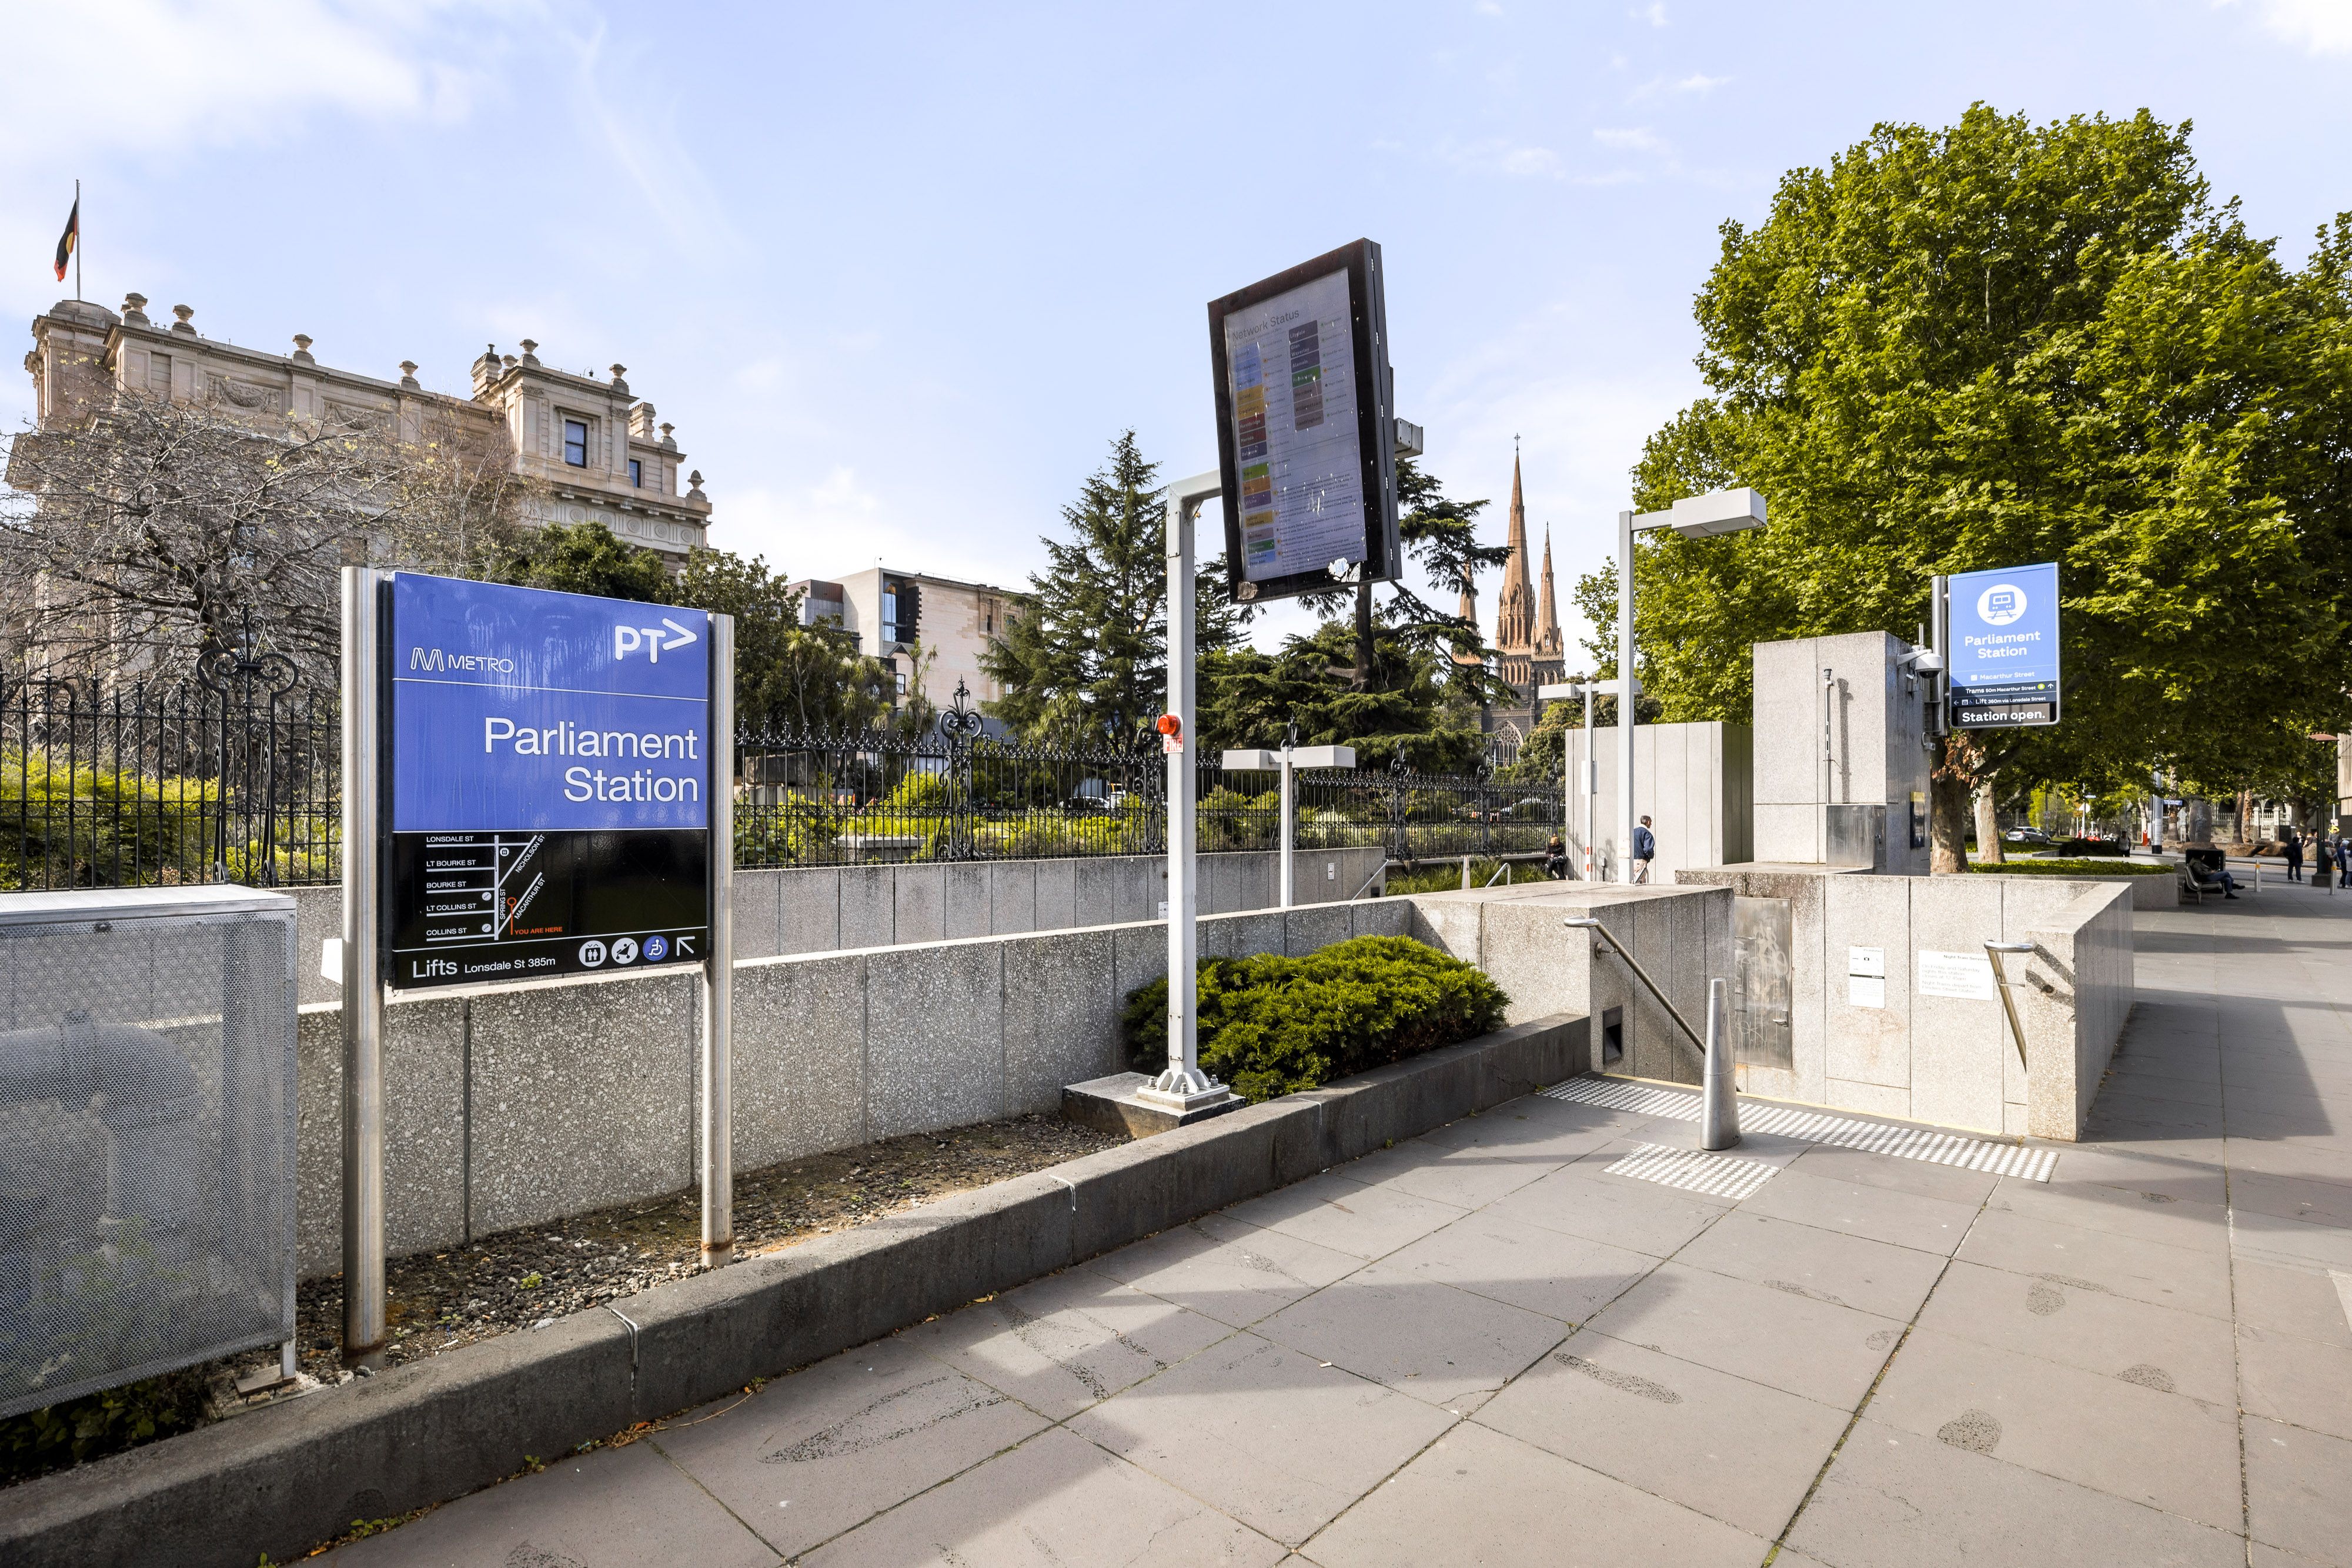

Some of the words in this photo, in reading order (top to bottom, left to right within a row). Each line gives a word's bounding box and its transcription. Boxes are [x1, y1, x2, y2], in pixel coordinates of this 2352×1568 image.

[1233, 320, 1268, 340] Network
[1271, 310, 1299, 327] Status
[1290, 330, 1305, 339] Lilydale
[1291, 348, 1309, 357] Waverley
[1296, 416, 1321, 426] Sandringham
[1965, 631, 2040, 647] Parliament
[1977, 646, 2027, 658] Station
[448, 654, 514, 673] METRO
[1962, 711, 2007, 722] Station
[2010, 711, 2046, 721] open.
[485, 717, 699, 760] Parliament
[1164, 738, 1182, 751] FIRE
[563, 767, 699, 803] Station
[515, 844, 540, 873] NICHOLSON
[537, 834, 545, 844] ST
[514, 884, 540, 920] MACARTHUR
[537, 878, 545, 887] ST
[413, 959, 457, 978] Lifts
[465, 961, 512, 974] Lonsdale
[514, 959, 525, 968] St
[528, 958, 555, 968] 385m
